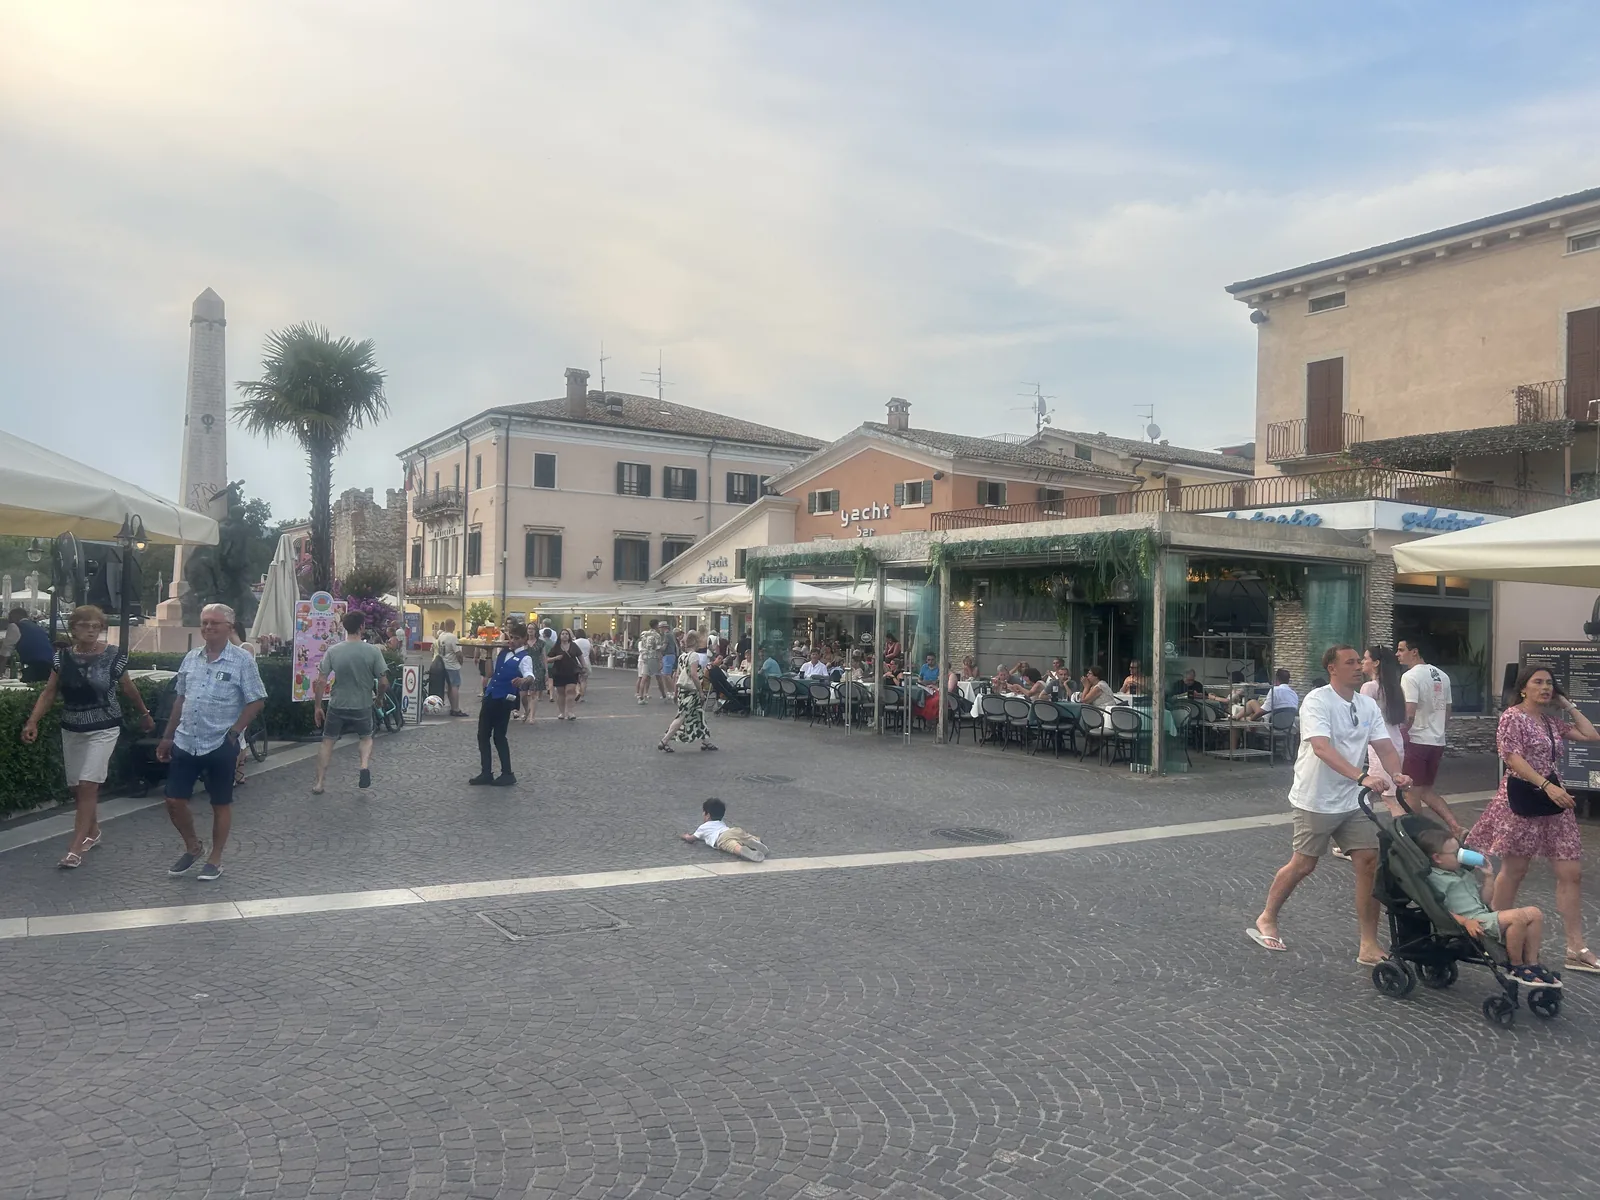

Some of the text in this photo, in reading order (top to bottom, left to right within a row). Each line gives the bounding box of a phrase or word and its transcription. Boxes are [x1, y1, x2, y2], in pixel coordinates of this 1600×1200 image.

[841, 501, 890, 527] yacht
[856, 525, 875, 537] bar
[707, 555, 728, 571] yacht
